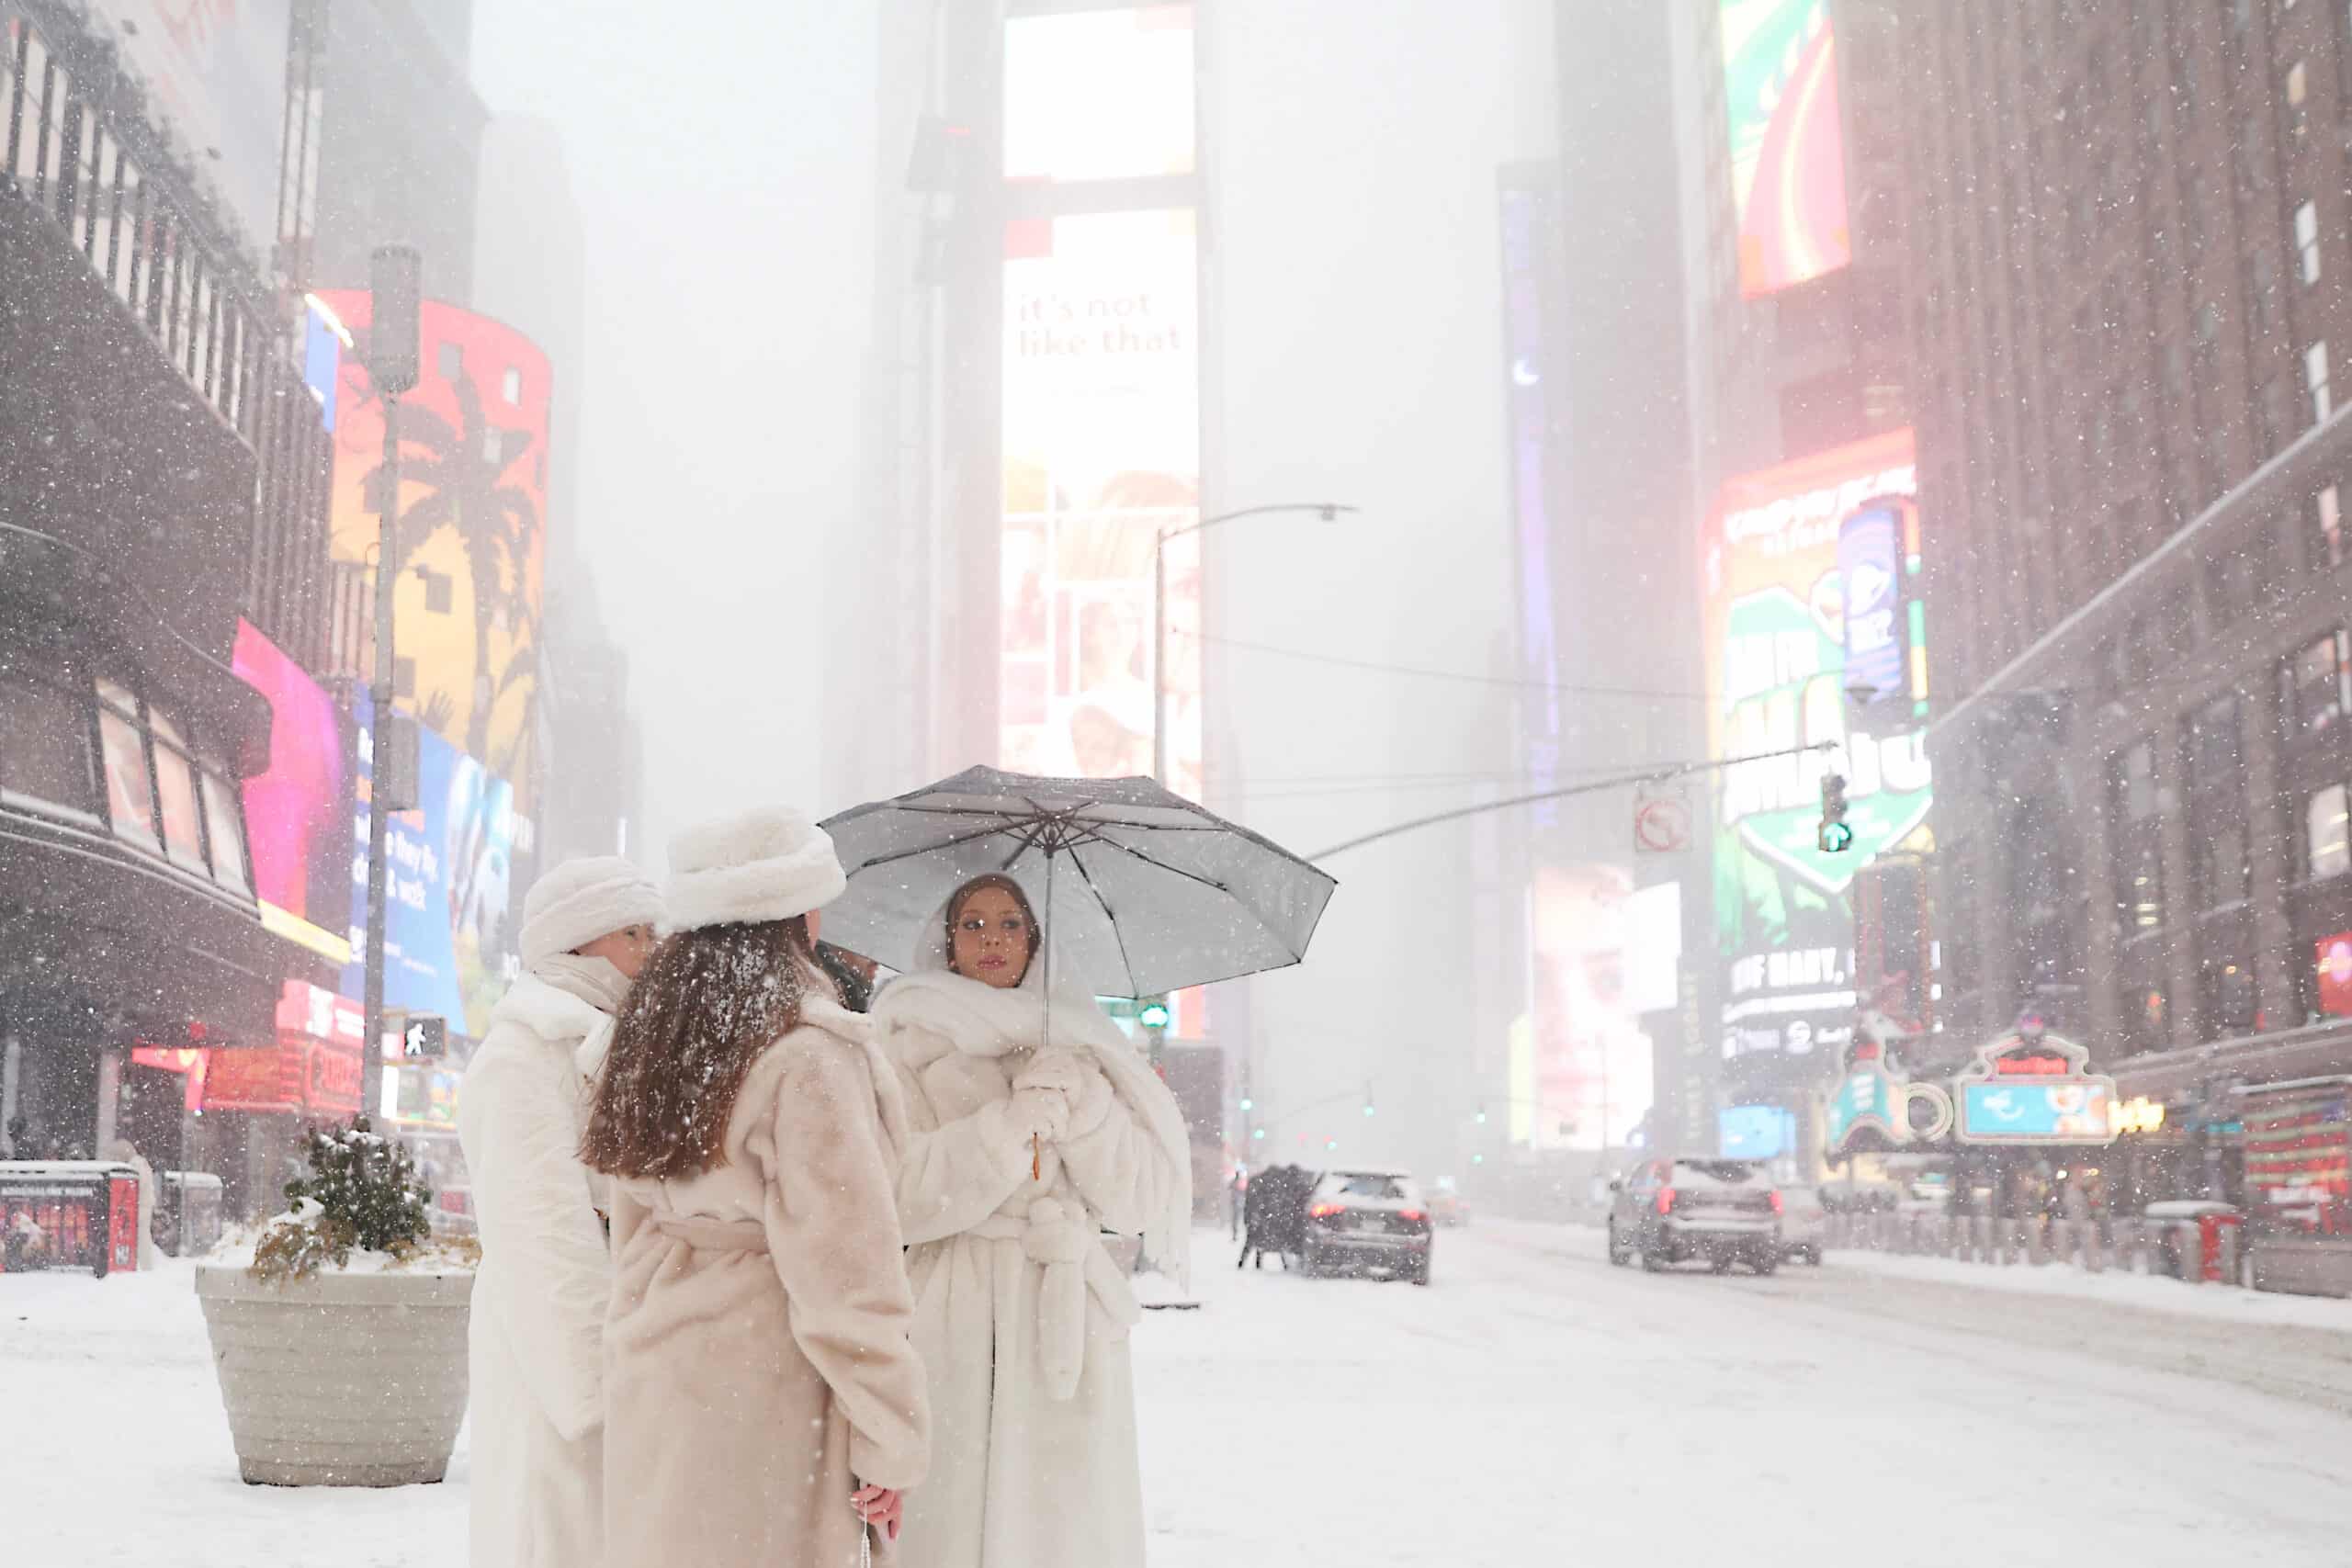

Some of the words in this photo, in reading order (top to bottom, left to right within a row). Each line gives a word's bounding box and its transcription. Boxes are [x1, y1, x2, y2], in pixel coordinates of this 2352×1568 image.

[1017, 293, 1073, 321] it's
[1088, 293, 1151, 317] not
[1017, 329, 1088, 356] like
[1102, 323, 1181, 355] that
